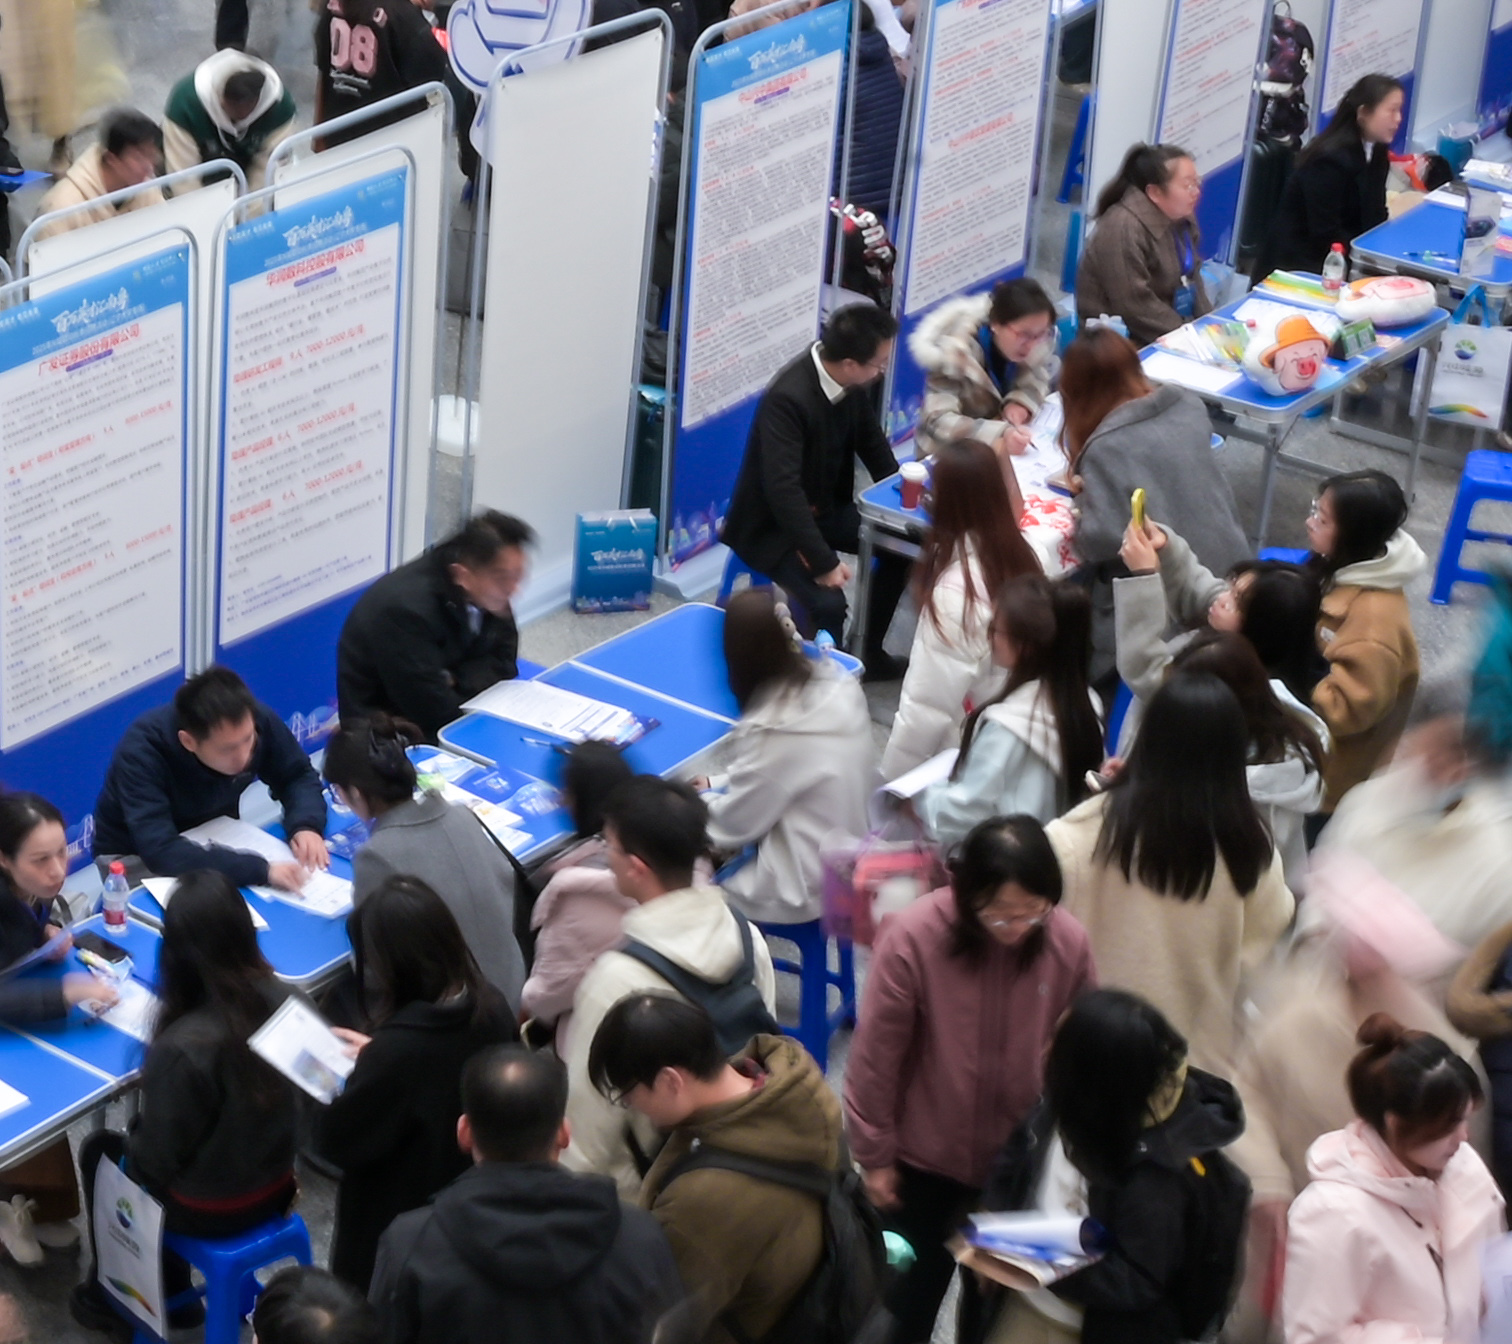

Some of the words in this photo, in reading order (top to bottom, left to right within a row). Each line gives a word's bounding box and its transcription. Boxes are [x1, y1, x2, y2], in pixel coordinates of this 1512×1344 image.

[36, 322, 142, 377] 广发证券股份有限公司
